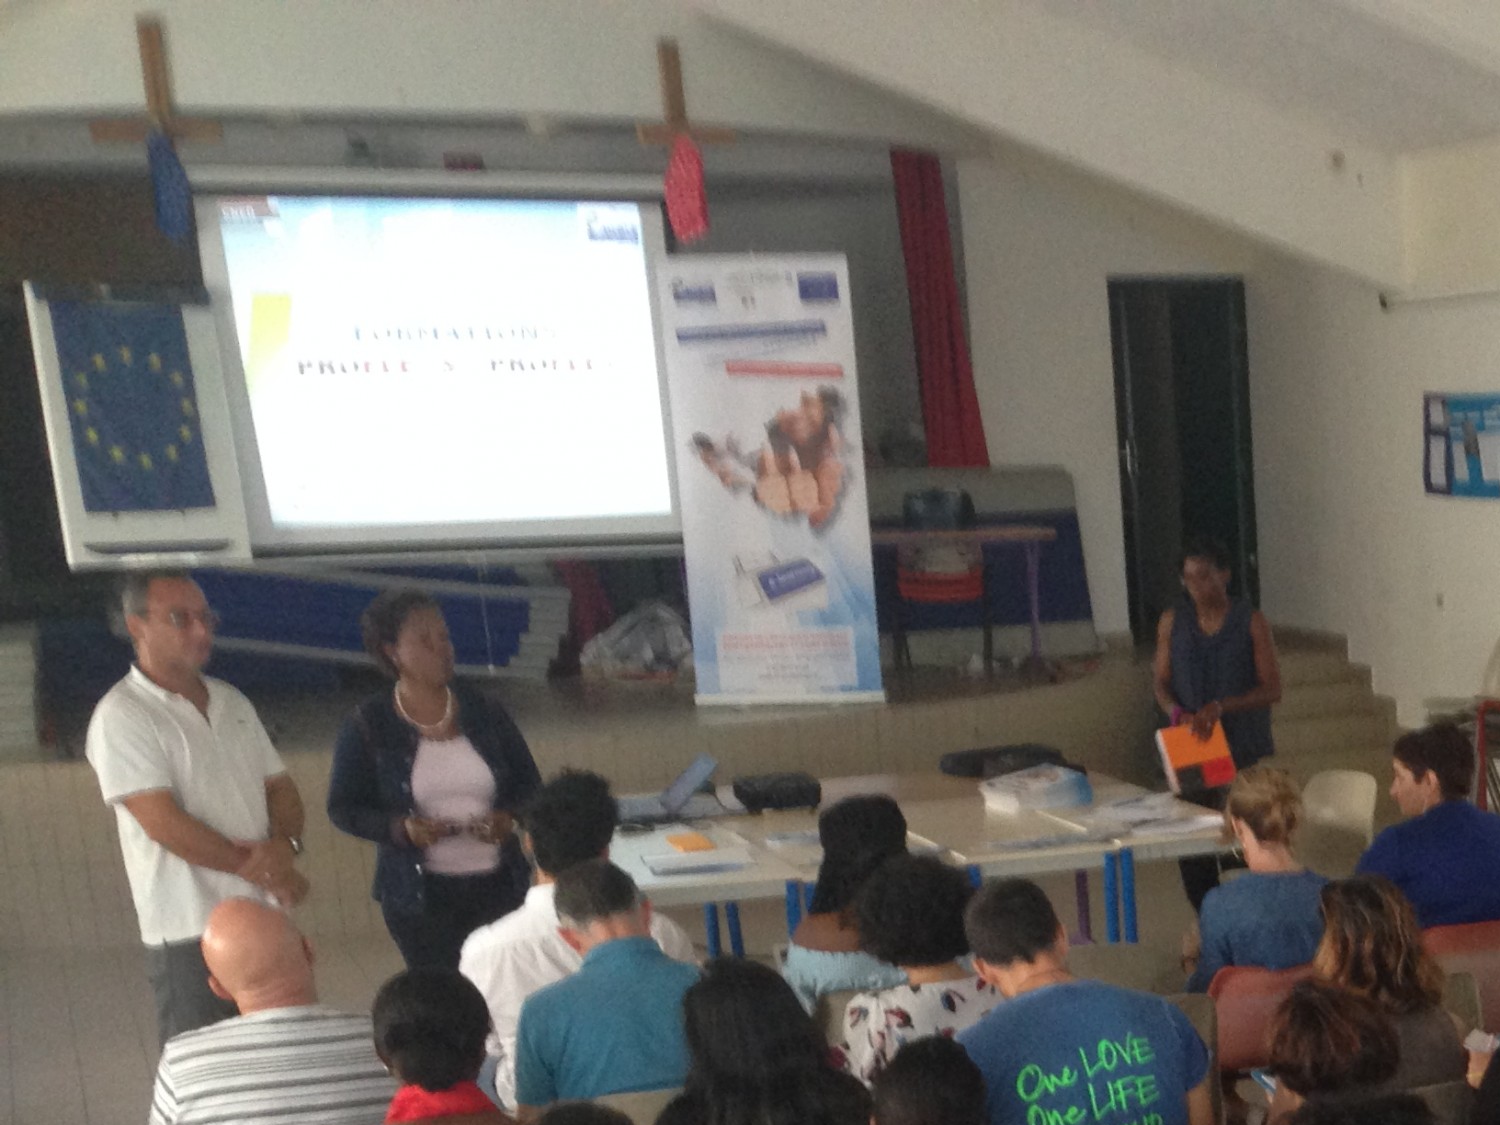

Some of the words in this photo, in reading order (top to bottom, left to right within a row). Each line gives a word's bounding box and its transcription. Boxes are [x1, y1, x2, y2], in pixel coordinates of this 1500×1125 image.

[1016, 1064, 1077, 1101] One
[1079, 1032, 1155, 1077] LOVE
[1088, 1075, 1159, 1119] LIFE
